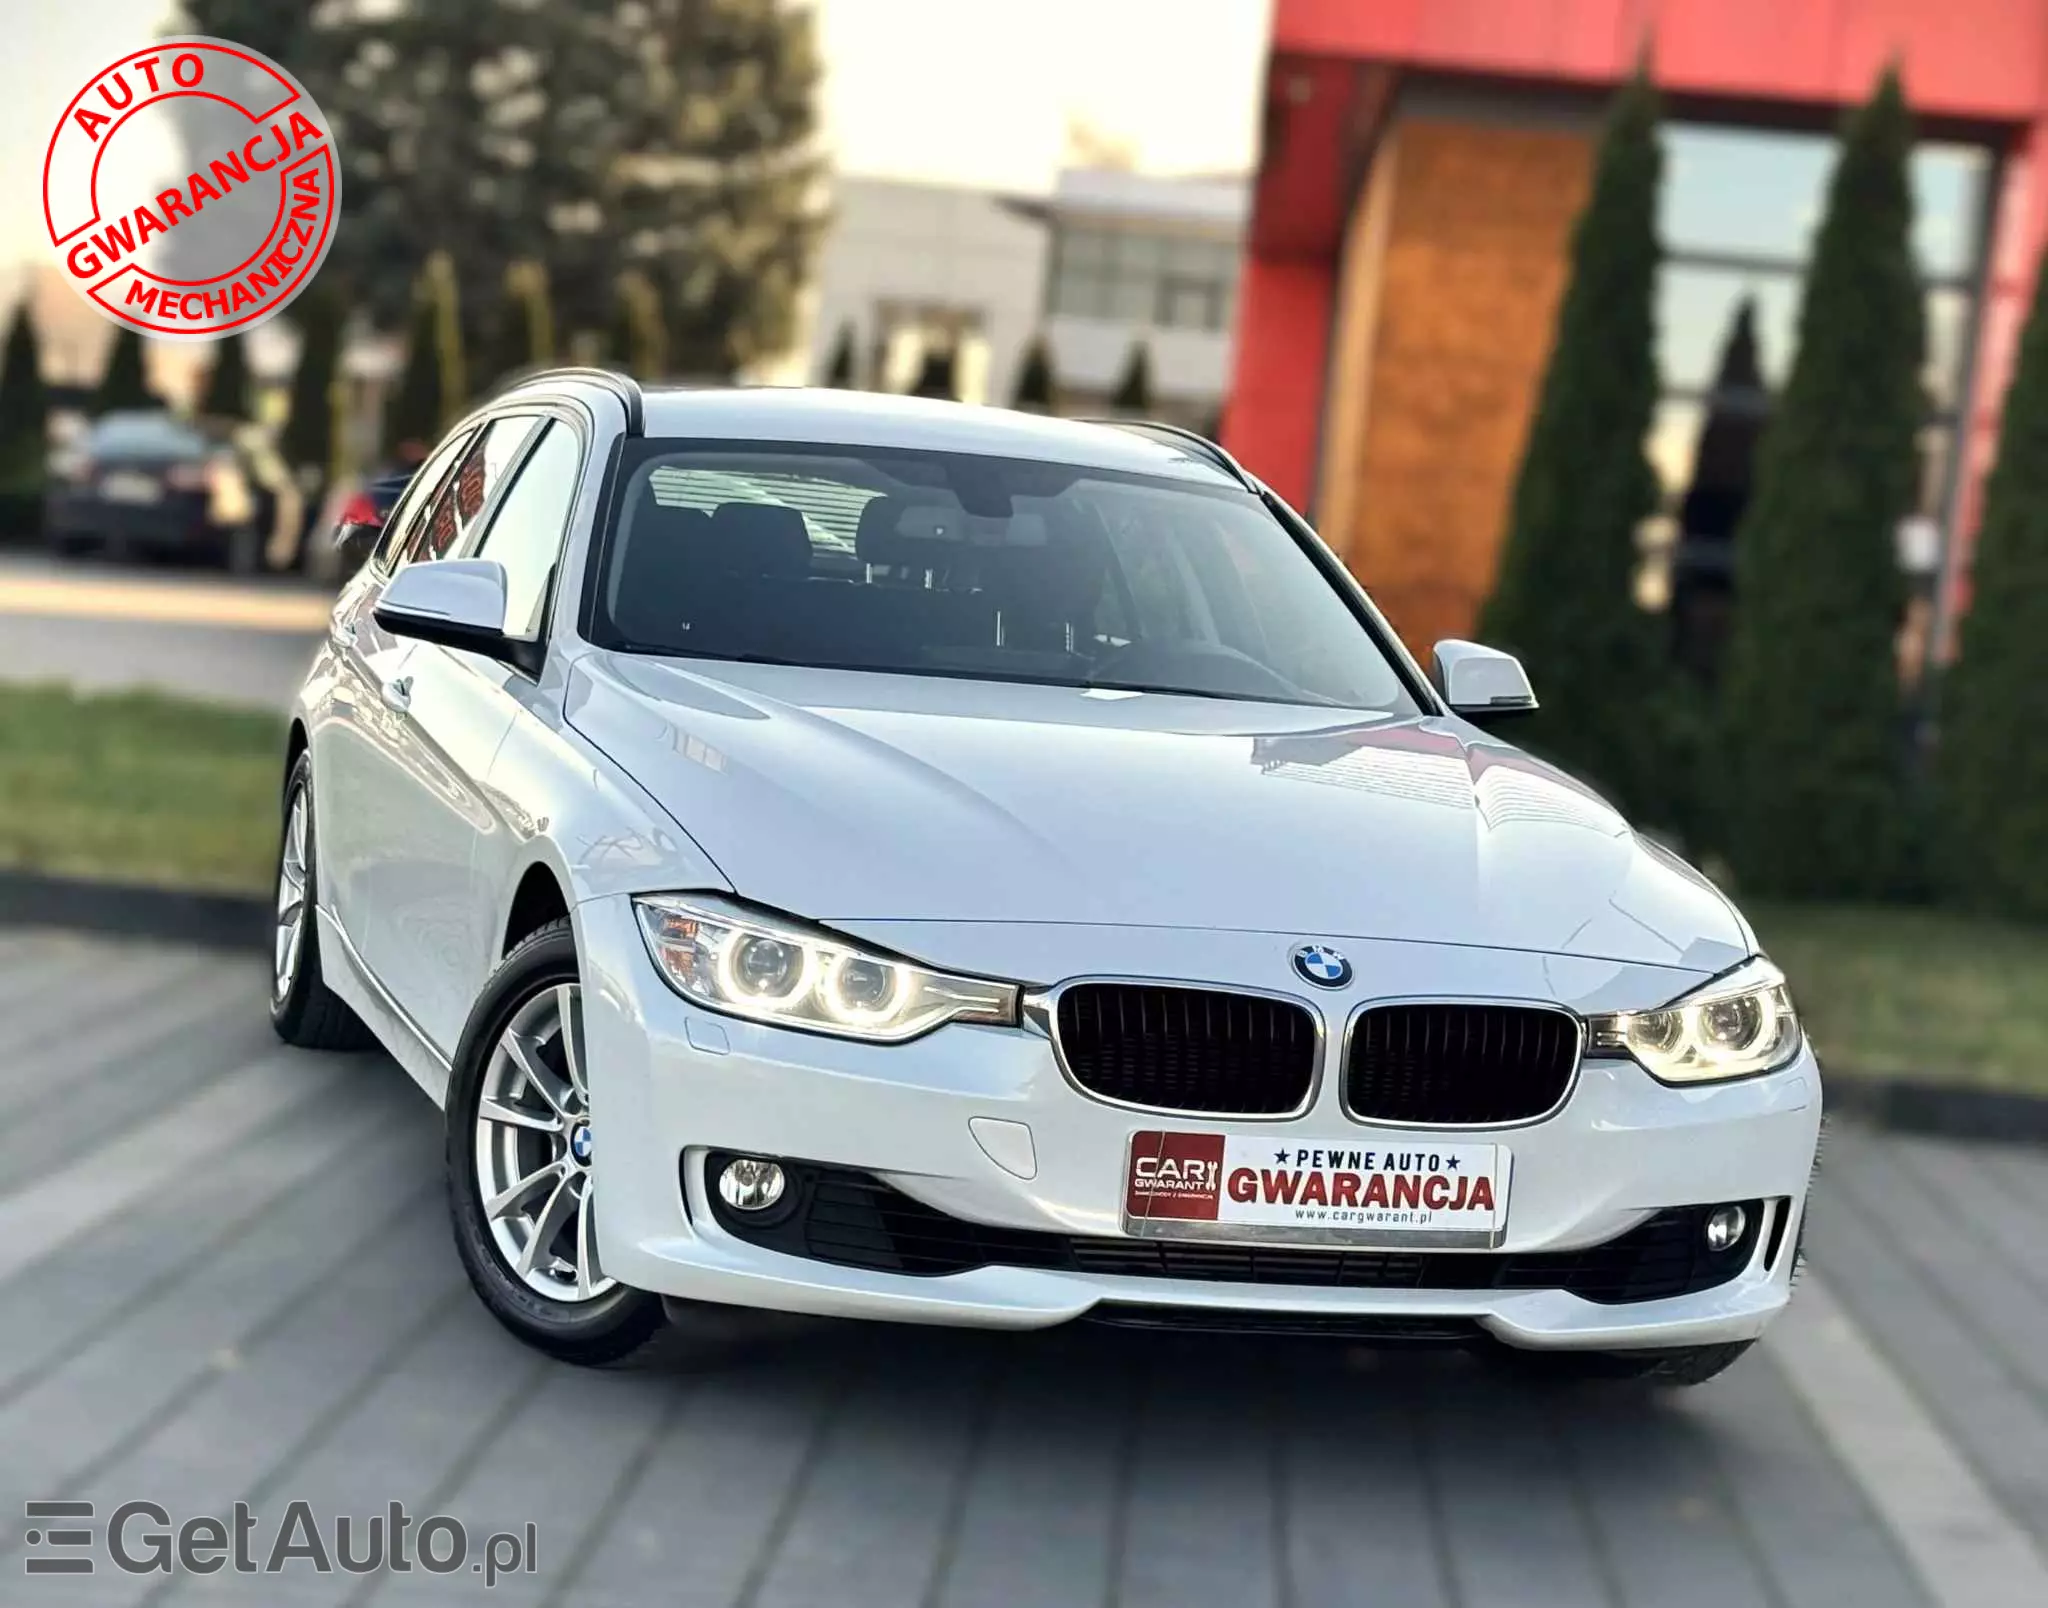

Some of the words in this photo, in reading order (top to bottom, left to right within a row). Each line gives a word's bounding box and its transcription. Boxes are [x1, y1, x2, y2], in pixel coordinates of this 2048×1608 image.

[1135, 1157, 1205, 1180] CAR
[1296, 1149, 1376, 1170] PEWNE
[1383, 1152, 1440, 1172] AUTO
[1134, 1178, 1204, 1191] GWARANT
[1227, 1167, 1494, 1211] GWARANCJA
[1295, 1209, 1432, 1224] www.cargwarant.pl
